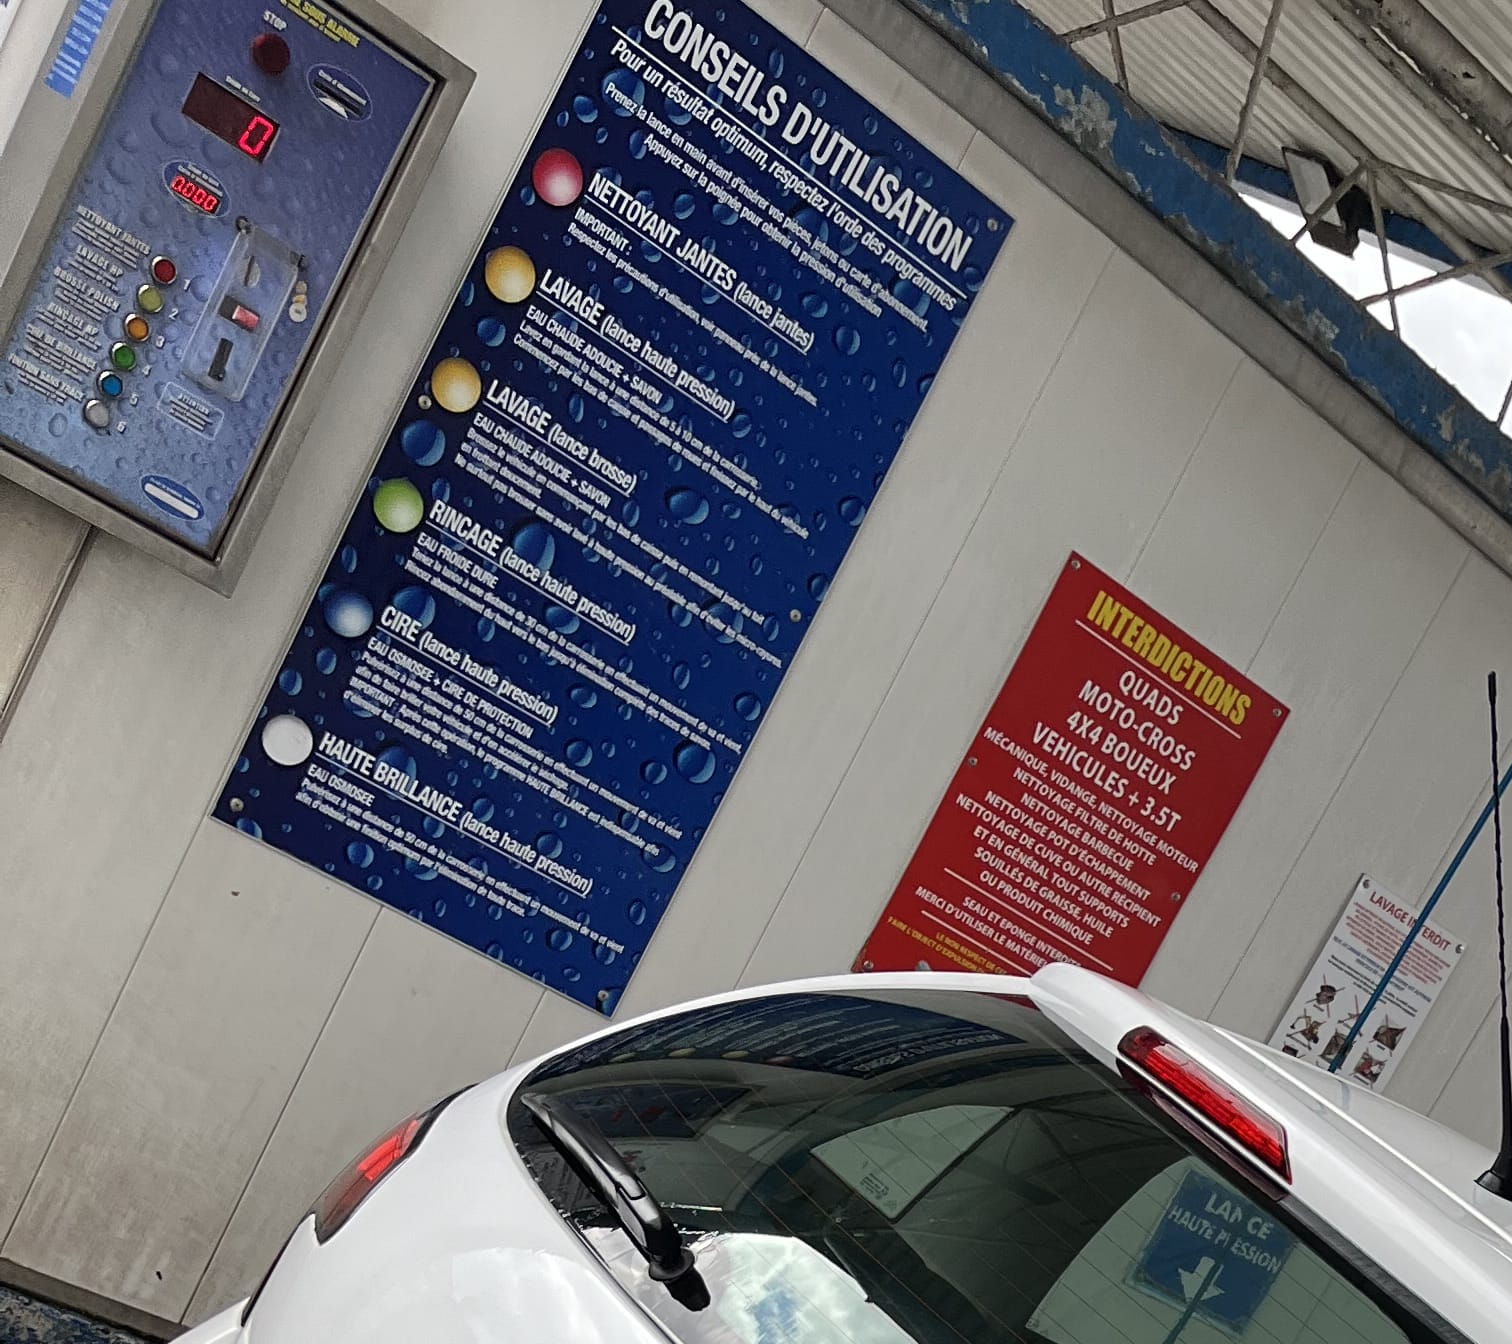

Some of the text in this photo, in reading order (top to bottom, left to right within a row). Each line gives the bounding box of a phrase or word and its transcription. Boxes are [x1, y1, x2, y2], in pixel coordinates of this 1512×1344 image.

[263, 10, 287, 30] STOP
[239, 116, 274, 156] 0
[610, 38, 956, 310] Pour un résultat optimum, respectez l'orde des programmes
[642, 0, 972, 271] CONSEILS D'UTILISATION
[574, 206, 629, 251] IMPORTANT
[605, 81, 637, 113] Prenez
[636, 104, 647, 120] la
[645, 111, 672, 138] lance
[671, 132, 684, 147] en
[683, 141, 707, 164] main
[705, 158, 732, 183] avant
[728, 176, 769, 210] d'insérer
[768, 204, 784, 222] vos
[781, 216, 811, 246] pièces,
[810, 236, 839, 263] jetons
[837, 258, 850, 272] ou
[849, 267, 871, 288] carte
[643, 133, 882, 317] Appuyez sur la poignée pour obtenir la pression d'utilisation
[183, 279, 191, 290] 1
[587, 172, 814, 352] NETTOYANT JANTES (lance jantes)
[156, 336, 165, 347] 3
[169, 308, 178, 320] 2
[526, 304, 548, 326] EAU
[546, 318, 585, 351] CHAUDE
[582, 343, 624, 378] ADOUCIE
[629, 375, 662, 404] SAVON
[539, 268, 735, 422] LAVAGE (lance haute pression)
[129, 393, 139, 405] 5
[142, 365, 151, 376] 4
[116, 421, 127, 434] 6
[473, 412, 495, 433] EAU
[493, 425, 533, 457] CHAUDE
[529, 449, 572, 483] ADOUCIE
[578, 480, 611, 508] SAVON
[486, 379, 551, 433] LAVAGE
[544, 423, 588, 460] (lance
[584, 447, 636, 494] brosse)
[417, 531, 498, 588] EAU FROIDE DURE
[429, 499, 635, 644] RINCAGE (lance haute pression)
[367, 636, 389, 656] EAU
[387, 648, 434, 681] OSMOSEE
[441, 678, 465, 699] CIRE
[463, 691, 478, 707] DE
[476, 698, 533, 738] PROTECTION
[380, 606, 558, 725] CIRE (lance haute pression)
[1087, 590, 1251, 724] INTERDICTIONS
[1119, 670, 1183, 724] QUADS
[1066, 711, 1176, 794] 4X4 BOUEUX
[1078, 679, 1195, 770] MOTO-CROSS
[307, 763, 374, 806] EAU OSMOSEE
[318, 731, 592, 897] HAUTE BRILLANCE (lance haute pression)
[983, 726, 1198, 872] MÉCANIQUE, VIDANGE, NETTOYAGE MOTEUR
[1013, 767, 1156, 865] NETTOYAGE FILTRE DE HOTTE
[1033, 721, 1181, 831] VEHICULES + 3.5T
[955, 793, 1161, 926] NETTOYAGE DE CUVE OU AUTRE RÉCIPIENT
[973, 825, 1129, 927] ET EN GÉNÉRAL TOUT SUPPORTS
[984, 790, 1150, 900] NETTOYAGE POT D'ÉCHAPPEMENT
[1020, 792, 1134, 871] NETTOYAGE BARBECUE
[915, 886, 946, 909] MERCI
[944, 903, 994, 938] D'UTILISER
[992, 931, 1006, 945] LE
[962, 896, 988, 916] SEAU
[987, 911, 1001, 923] ET
[999, 918, 1036, 945] EPONGE
[974, 846, 1113, 937] SOUILLÉS DE GRAISSE, HUILE
[979, 870, 1093, 944] OU PRODUIT CHIMIQUE
[1369, 891, 1451, 951] LAVAGE IERDIT
[1168, 1205, 1216, 1240] HAUTE
